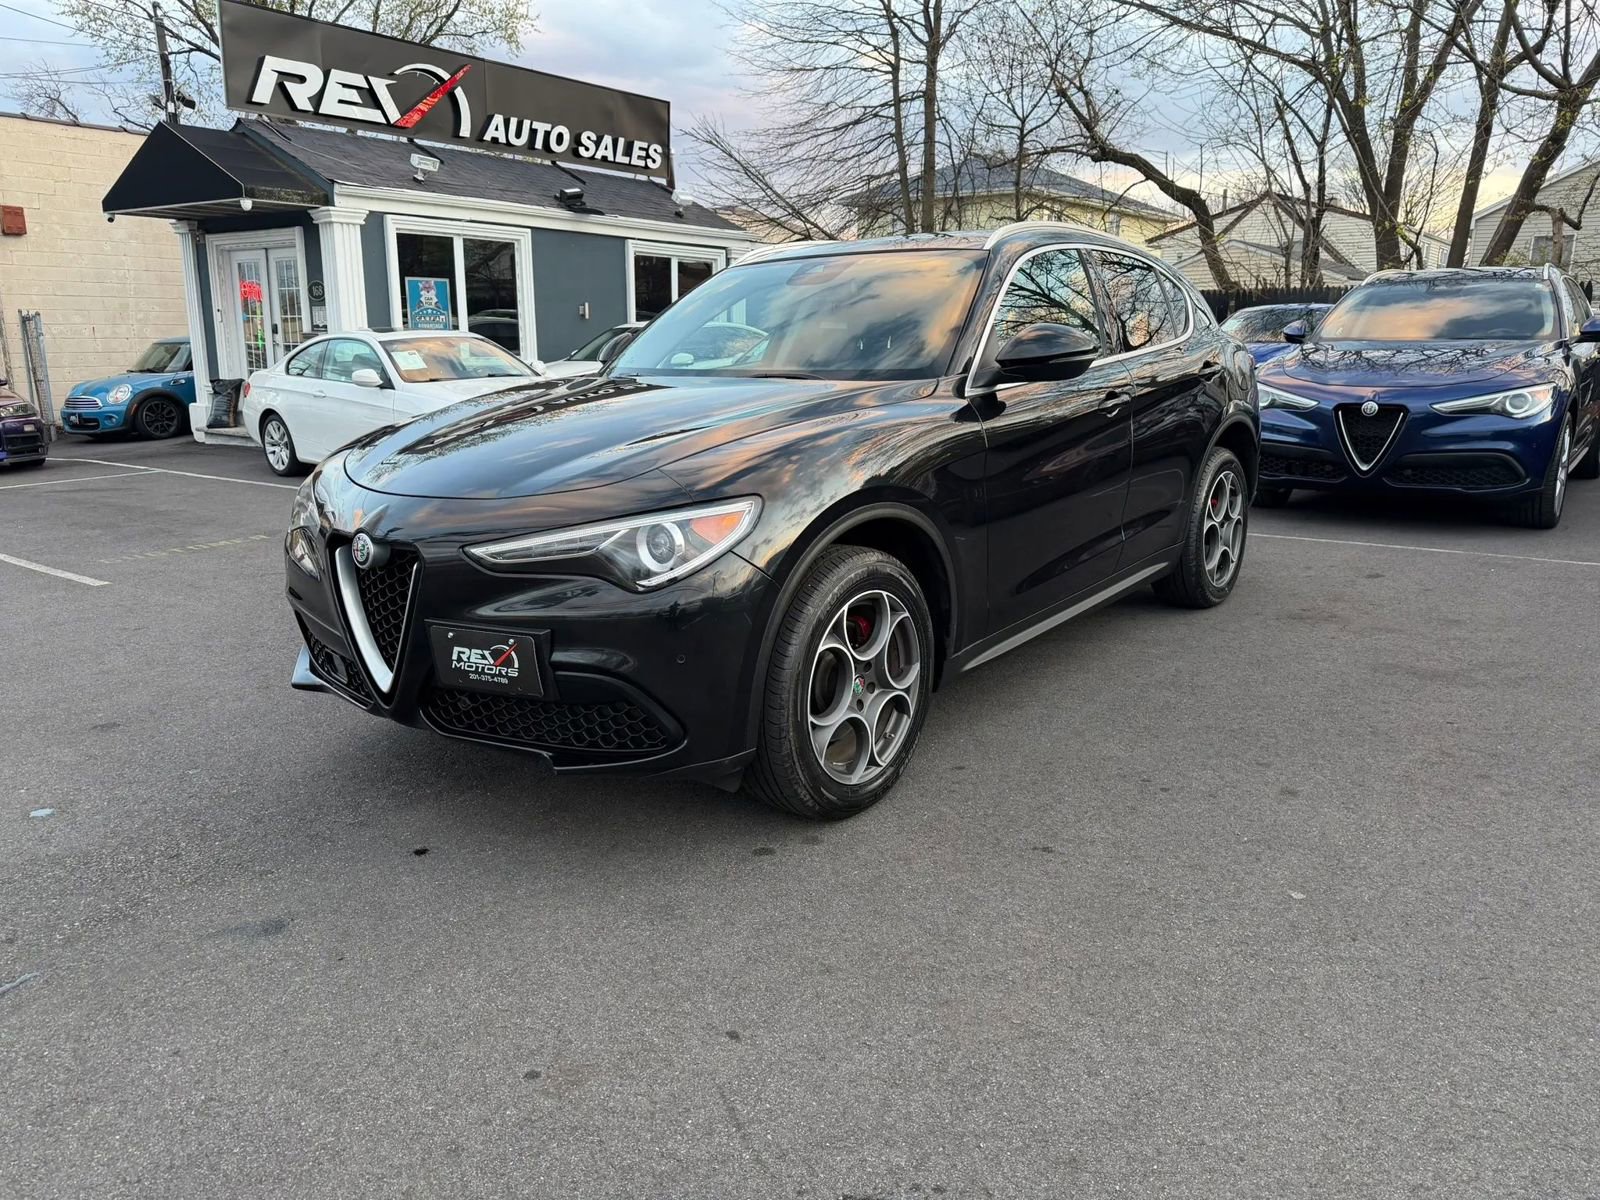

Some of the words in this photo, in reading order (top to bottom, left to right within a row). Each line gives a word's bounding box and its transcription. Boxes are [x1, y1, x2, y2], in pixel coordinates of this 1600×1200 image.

[483, 113, 571, 154] AUTO
[578, 130, 663, 170] SALES
[451, 660, 519, 677] MOTORS
